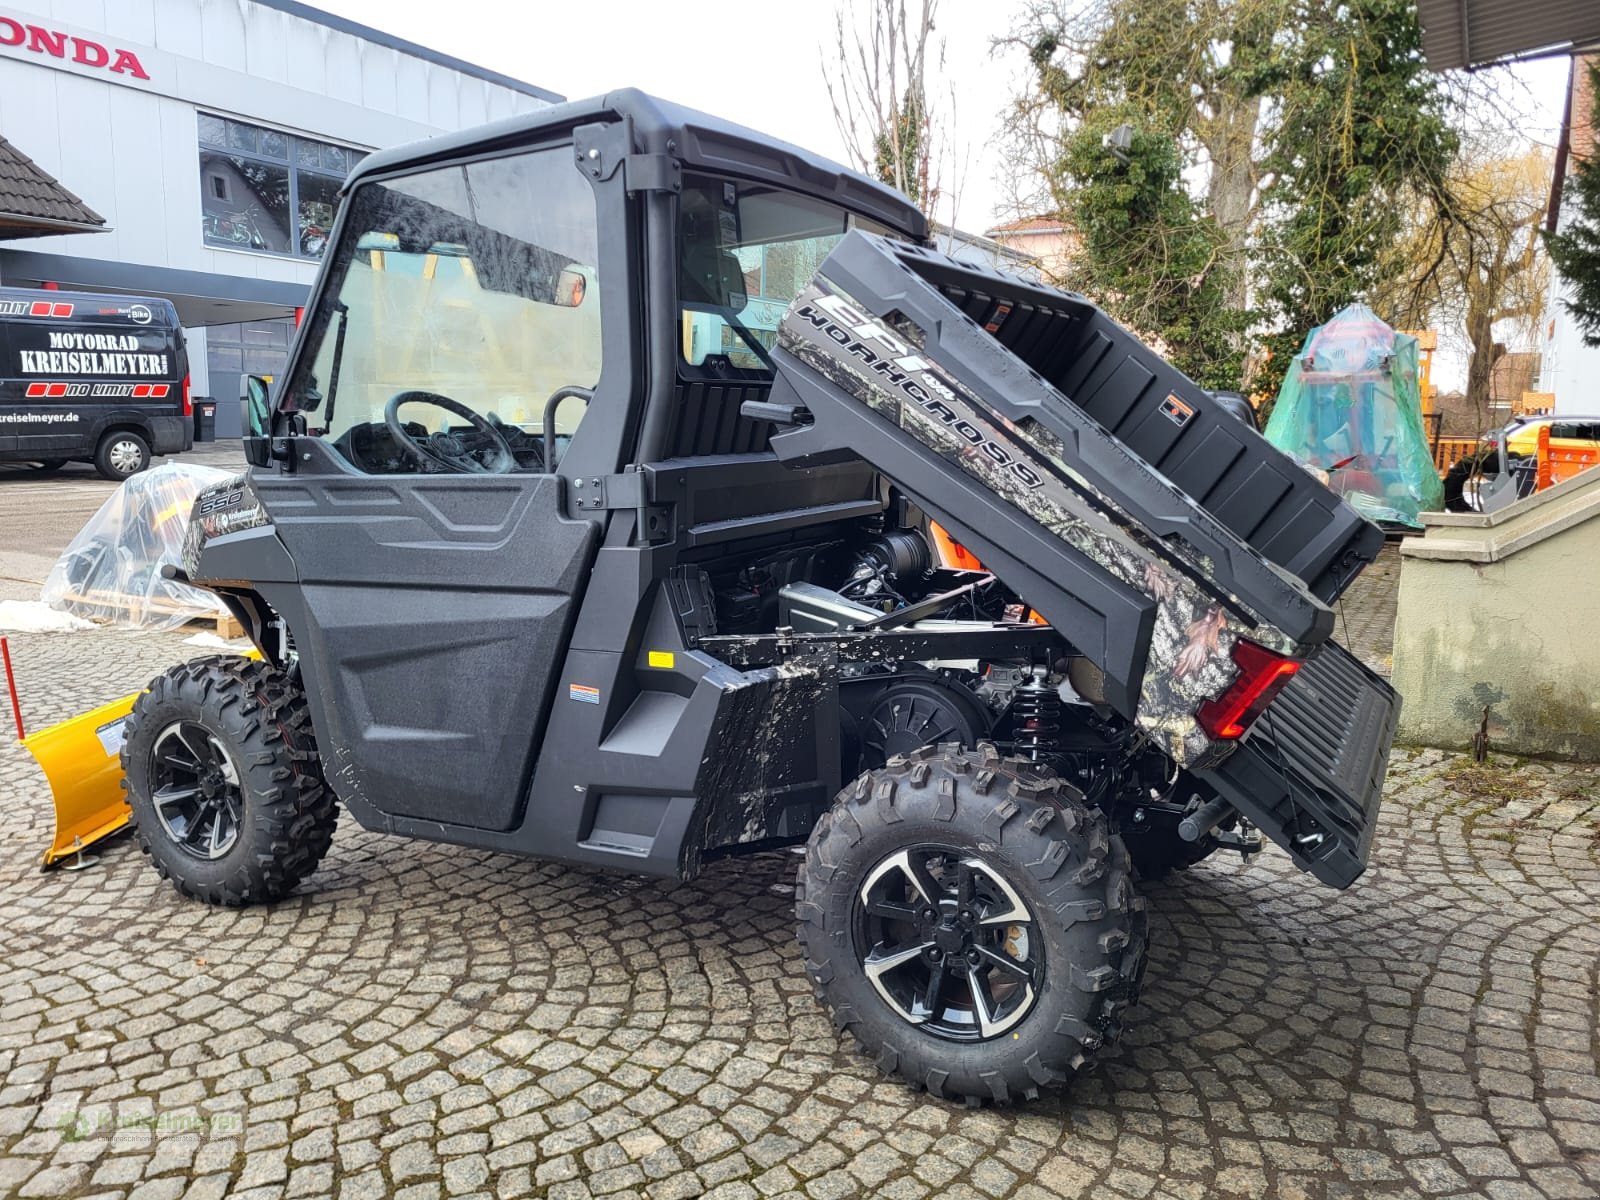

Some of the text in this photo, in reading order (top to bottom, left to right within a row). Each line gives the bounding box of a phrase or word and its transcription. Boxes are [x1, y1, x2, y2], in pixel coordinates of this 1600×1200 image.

[131, 310, 149, 319] Bike
[48, 332, 140, 351] MOTORRAD
[812, 294, 931, 372] EFI
[20, 351, 162, 375] KREISELMEYER
[796, 305, 1044, 489] WORKCROSS
[200, 490, 244, 515] 650
